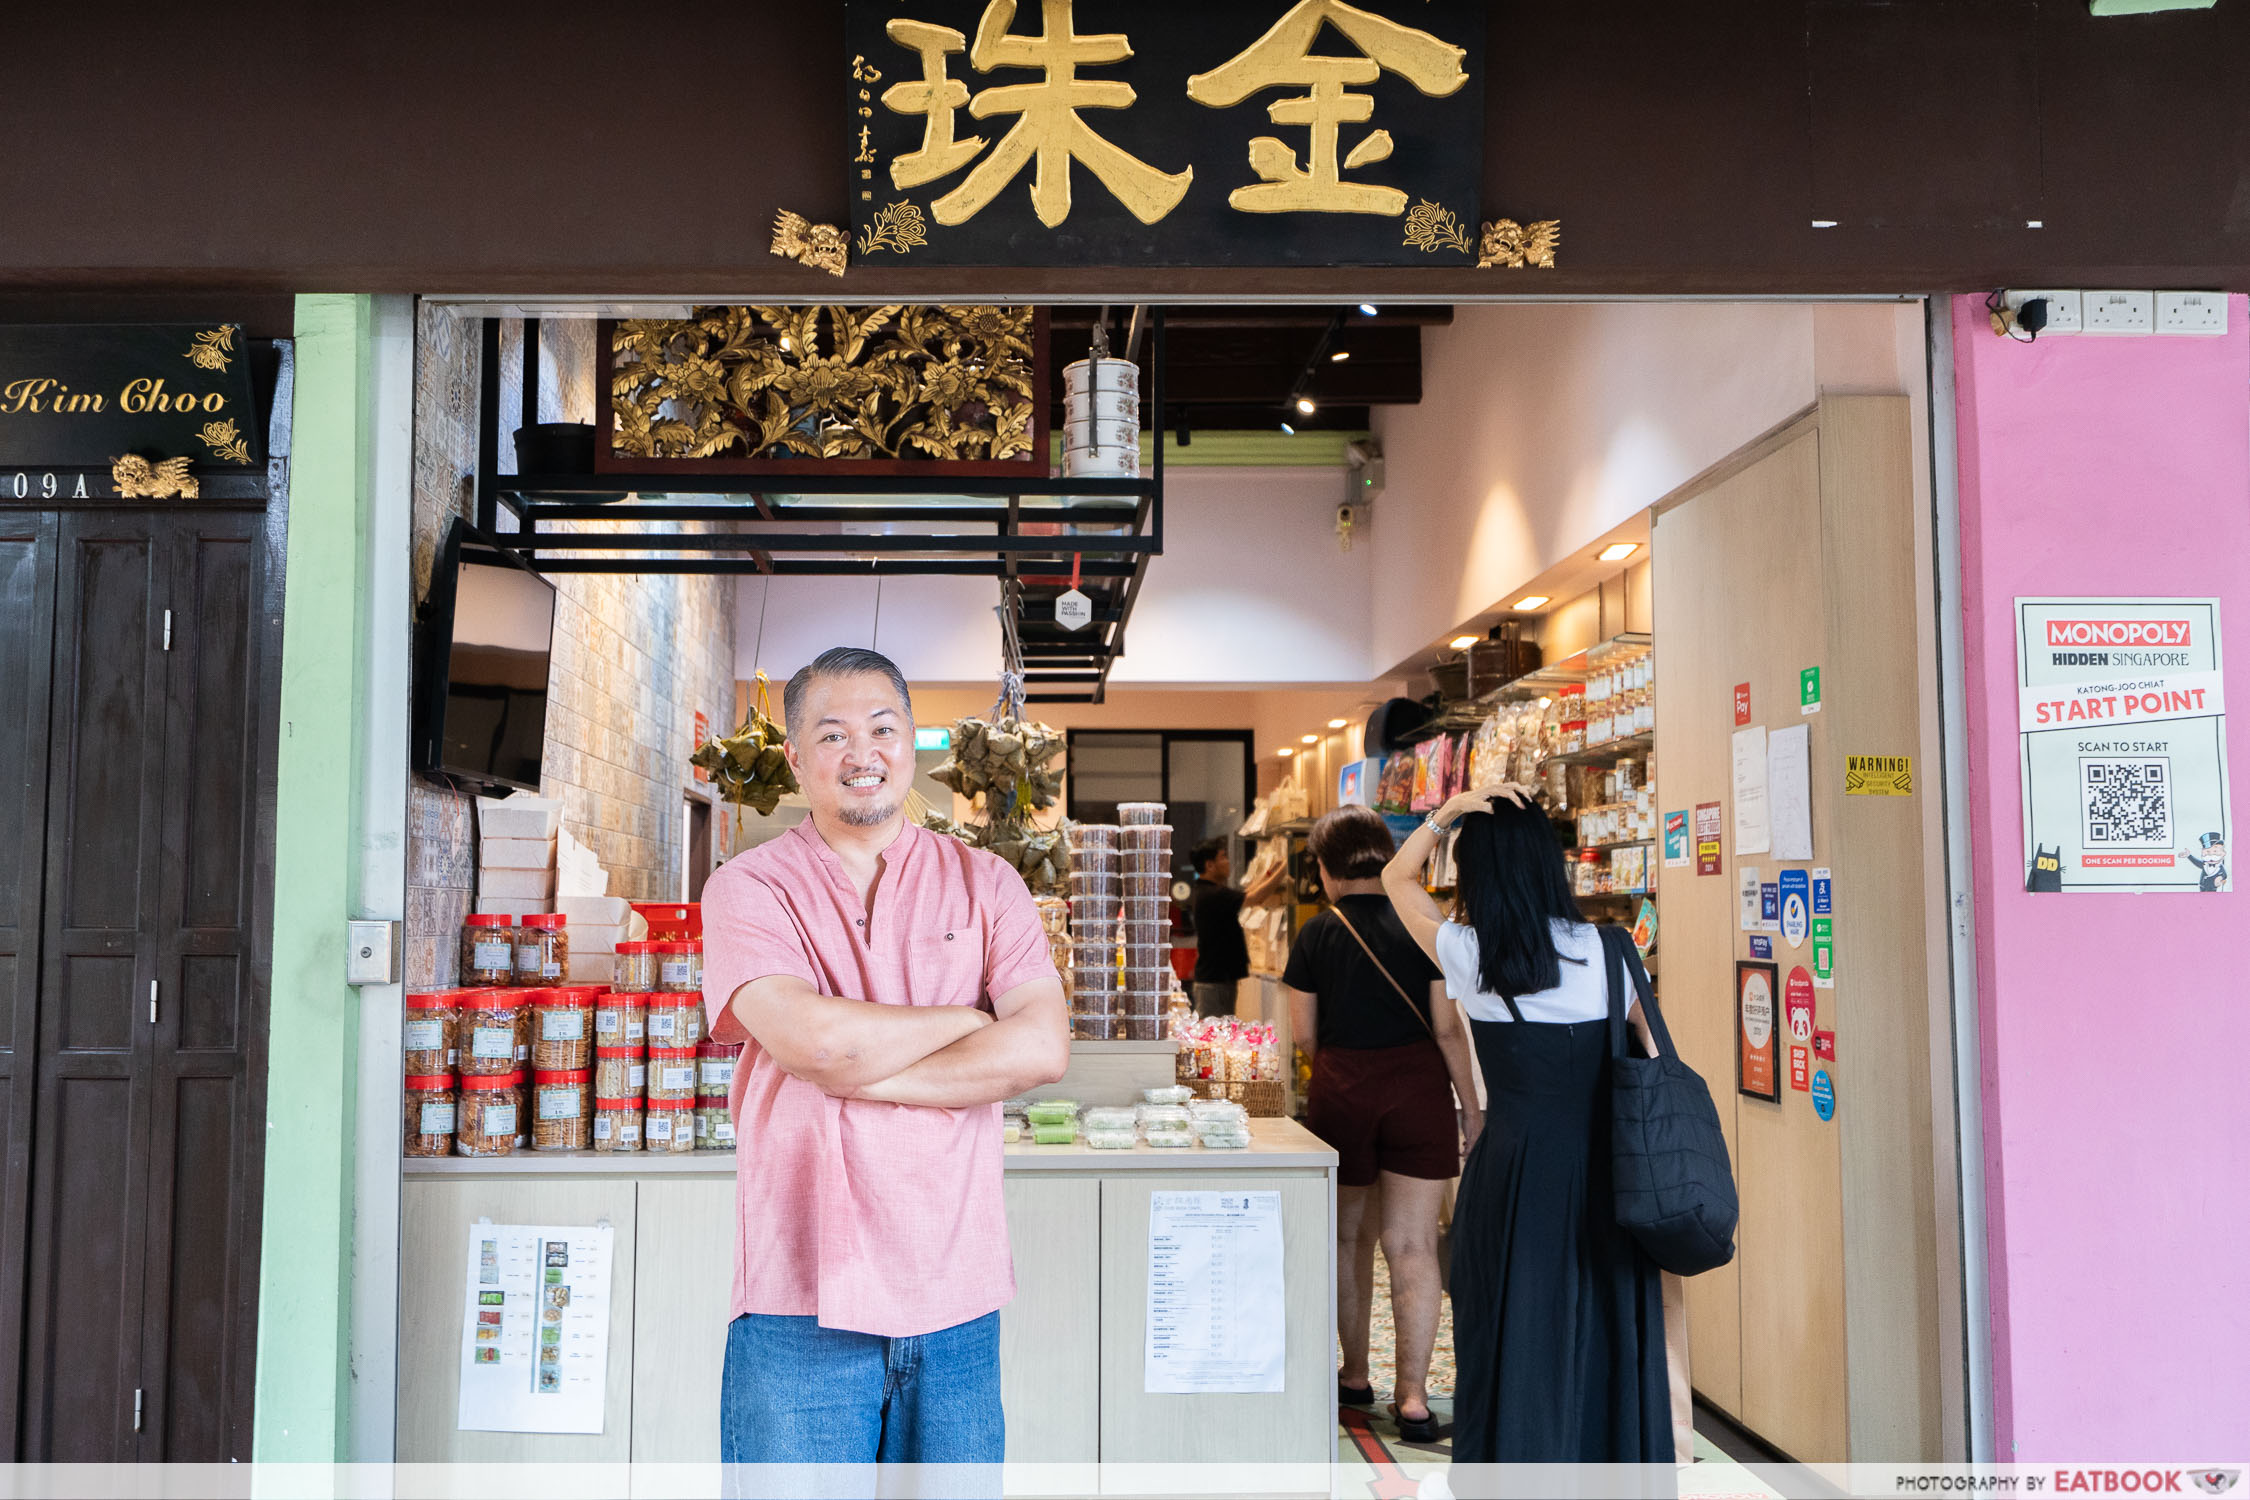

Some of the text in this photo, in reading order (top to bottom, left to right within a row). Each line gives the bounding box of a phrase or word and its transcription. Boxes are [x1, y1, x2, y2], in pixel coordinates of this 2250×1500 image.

[0, 377, 231, 414] Kim Choo
[2050, 622, 2188, 644] MONOPOLY
[2052, 652, 2190, 666] HIDDEN SINGAPORE
[2077, 680, 2165, 695] KATONG-JOO CHIAT
[2036, 688, 2206, 723] START POINT
[2078, 742, 2169, 752] SCAN TO START
[1849, 756, 1909, 772] WARNING!
[2085, 857, 2172, 865] ONE SCAN PER BOOKING
